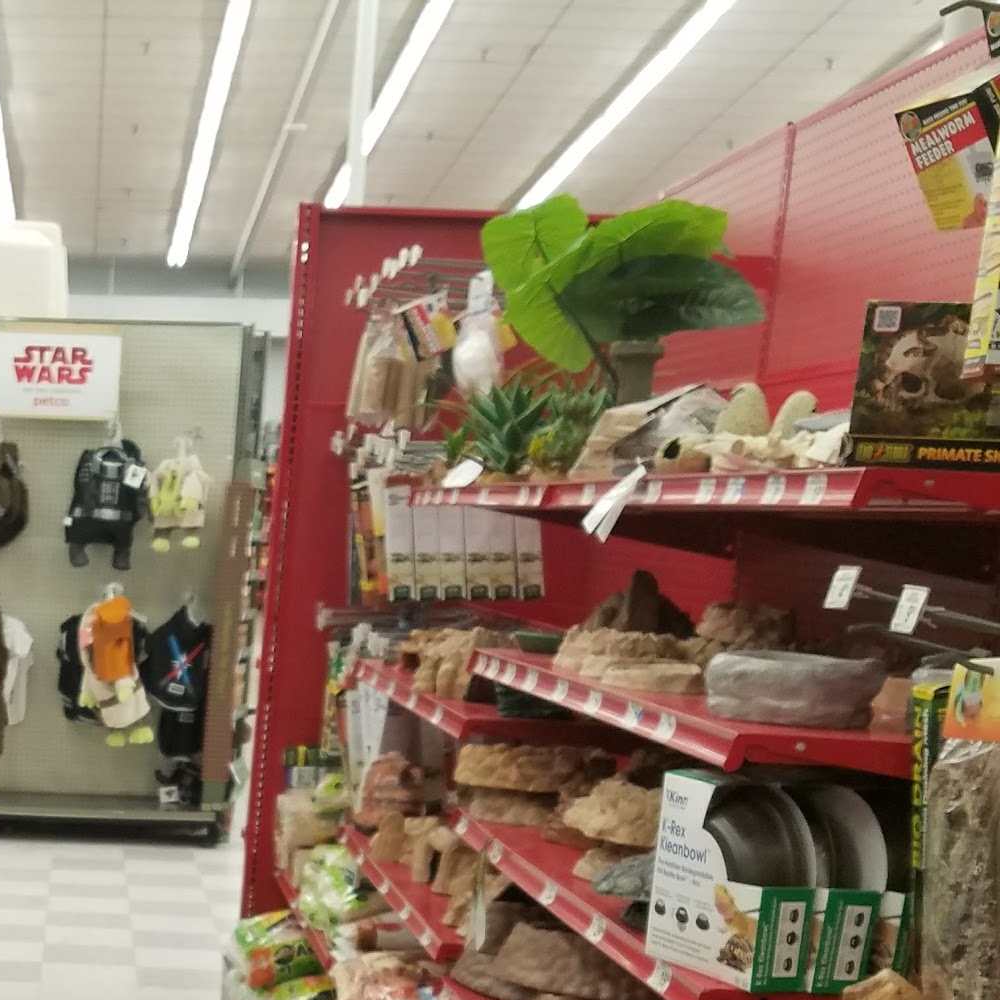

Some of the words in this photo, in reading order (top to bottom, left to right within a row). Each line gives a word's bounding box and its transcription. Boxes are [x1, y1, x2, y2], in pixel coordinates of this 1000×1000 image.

[911, 111, 976, 155] MEALWORM
[916, 140, 955, 169] FEEDER
[14, 346, 92, 365] STAR
[15, 365, 92, 384] WARS
[918, 447, 982, 461] PRIMATE
[662, 818, 686, 838] K-Rex
[660, 834, 707, 864] Kleanbowl
